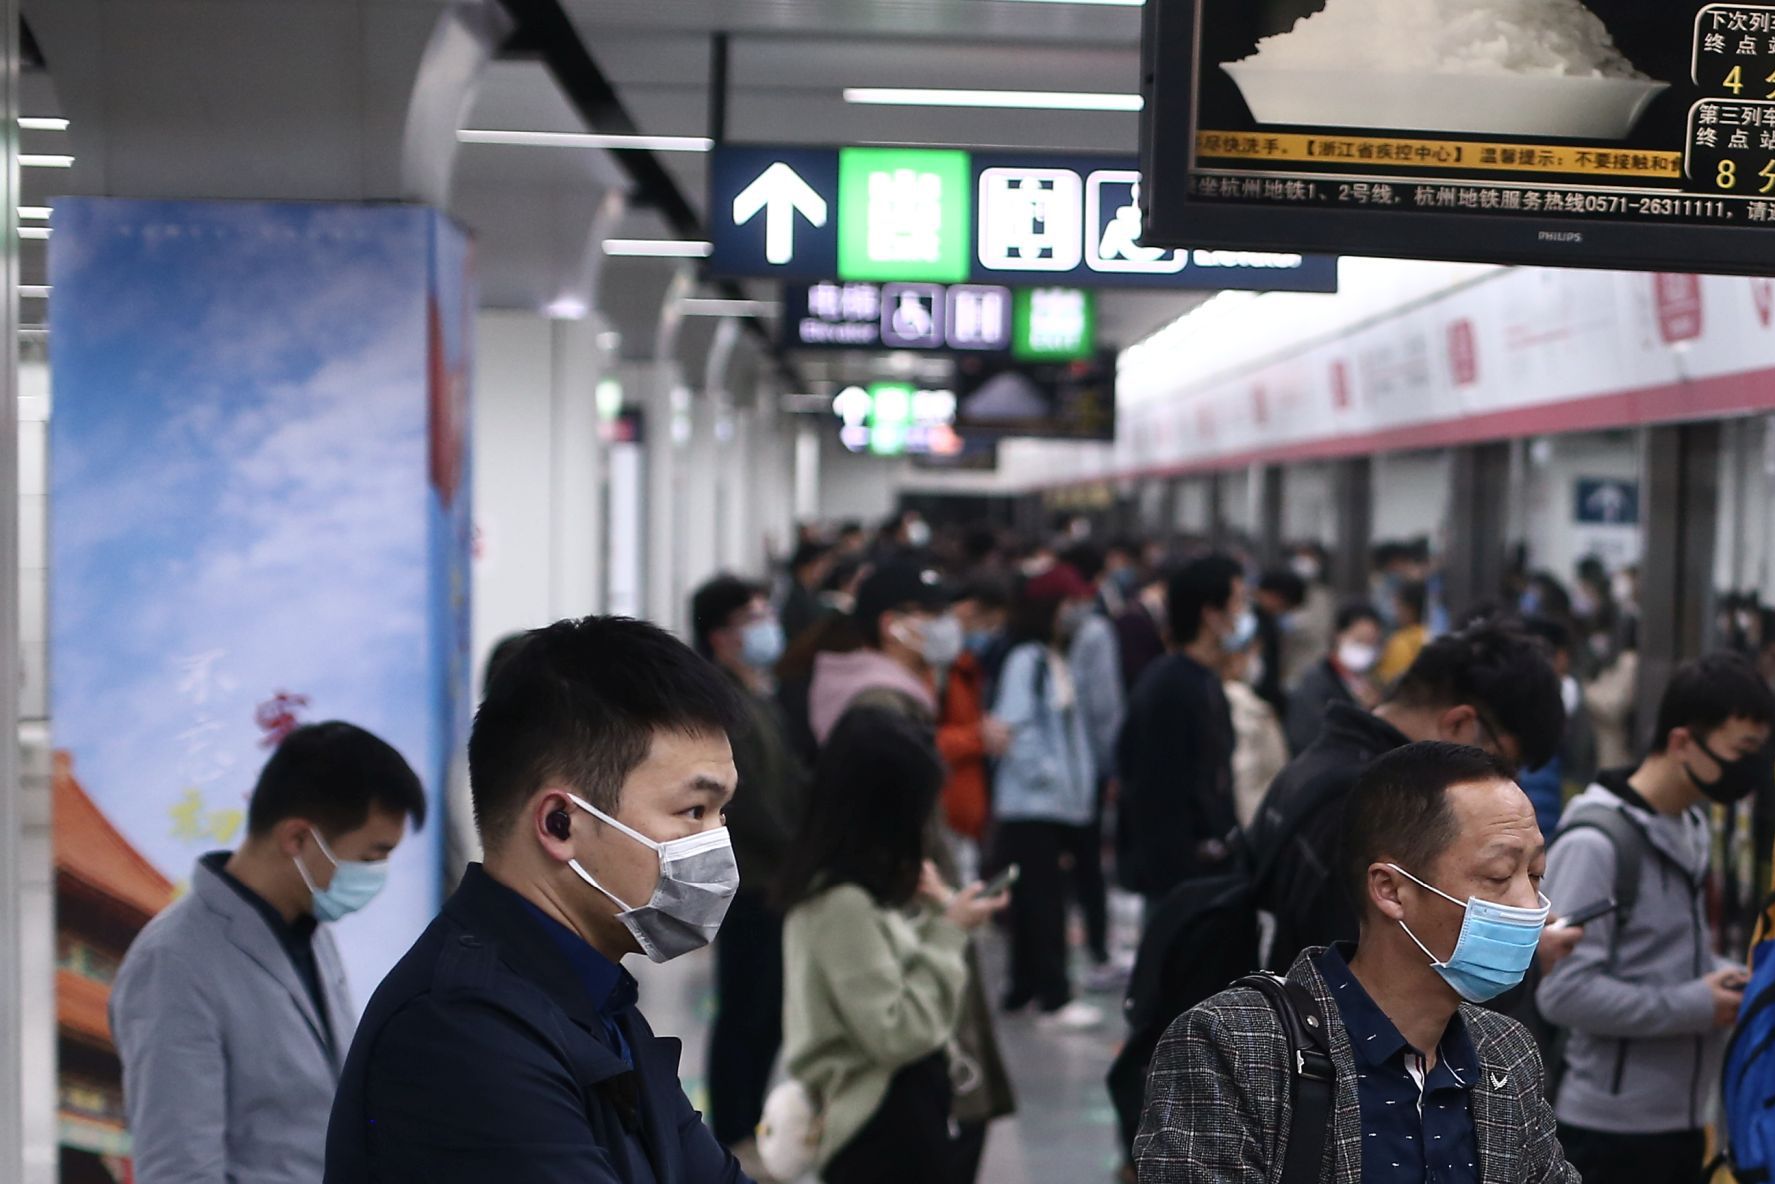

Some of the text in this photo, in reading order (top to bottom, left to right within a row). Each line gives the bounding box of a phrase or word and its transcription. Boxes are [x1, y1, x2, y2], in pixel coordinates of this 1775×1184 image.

[1721, 65, 1744, 95] 4
[1715, 159, 1738, 189] 8
[1538, 231, 1582, 242] PHILIPS
